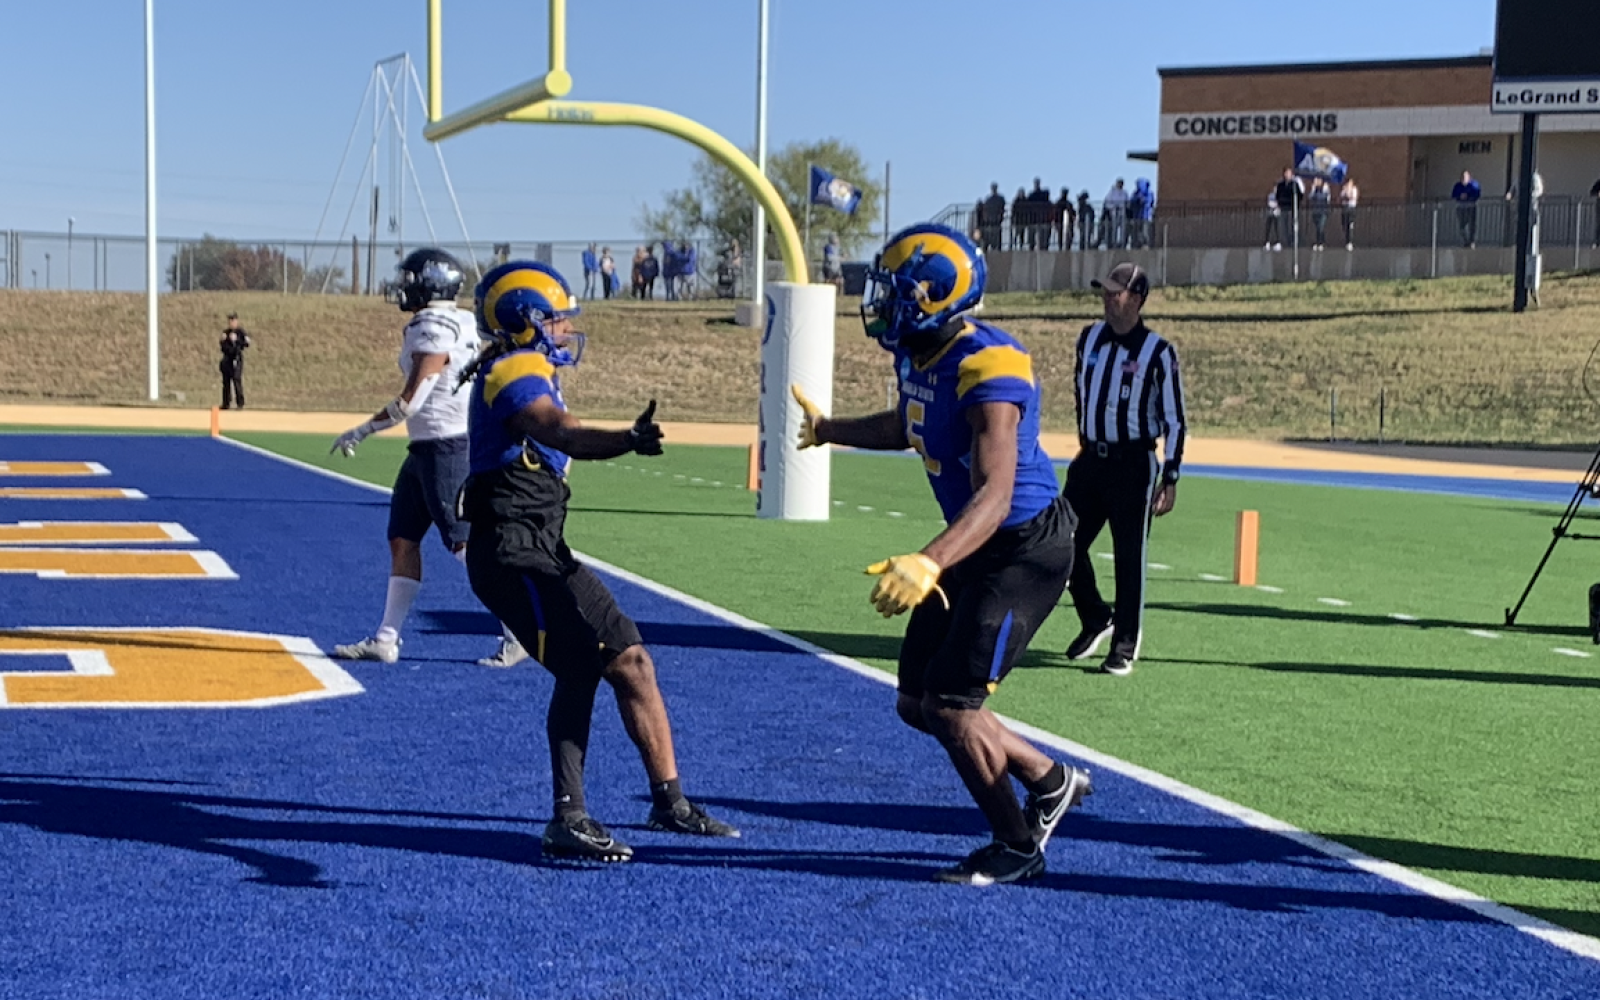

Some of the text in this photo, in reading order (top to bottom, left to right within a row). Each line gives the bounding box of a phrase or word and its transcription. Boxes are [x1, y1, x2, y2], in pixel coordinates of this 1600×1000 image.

[1495, 88, 1580, 105] LeGrand
[1174, 113, 1338, 136] CONCESSIONS
[1458, 141, 1492, 154] MEN
